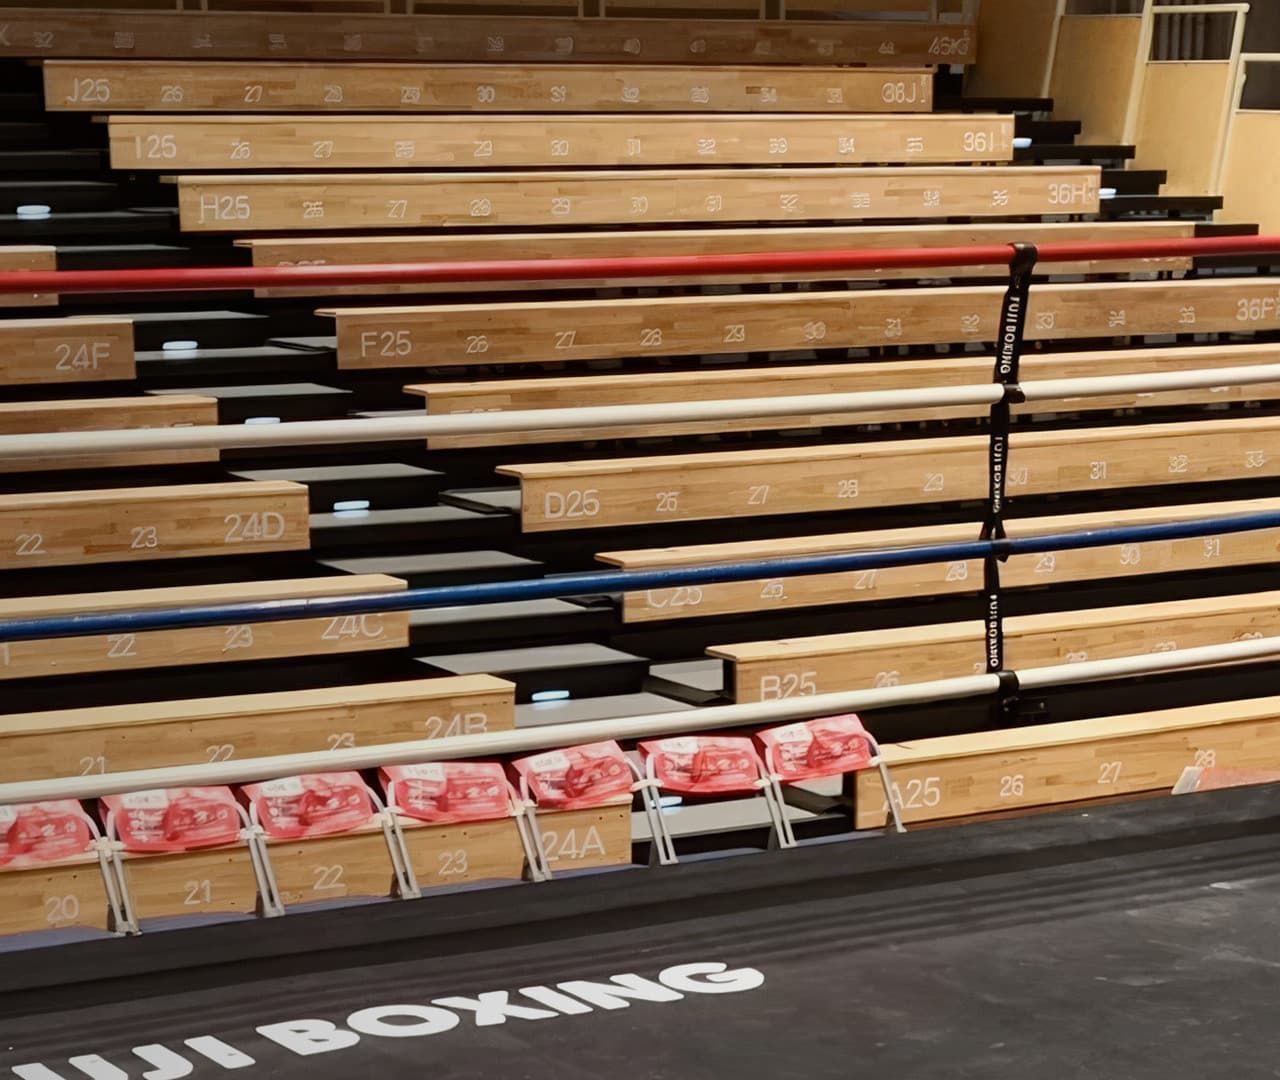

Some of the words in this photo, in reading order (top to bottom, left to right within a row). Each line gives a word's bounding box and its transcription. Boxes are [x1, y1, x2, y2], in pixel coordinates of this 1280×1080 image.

[67, 78, 111, 103] J25
[198, 194, 250, 225] H25
[1047, 183, 1086, 204] 36H
[361, 330, 412, 357] F25
[554, 330, 577, 350] 27
[1236, 299, 1275, 321] 36F
[55, 344, 111, 371] 24F
[544, 489, 600, 519] D25
[748, 485, 770, 505] 27
[838, 480, 859, 498] 28
[15, 533, 48, 556] 22
[131, 526, 158, 549] 23
[224, 512, 285, 543] 24D
[106, 634, 136, 657] 22
[79, 754, 106, 774] 21
[883, 777, 940, 810] A25
[1001, 775, 1024, 796] 26
[1099, 761, 1122, 784] 27
[47, 895, 78, 920] 20
[185, 880, 210, 905] 21
[313, 864, 345, 889] 22
[438, 849, 467, 874] 23
[542, 825, 605, 860] 24A
[256, 961, 765, 1055] BOXING
